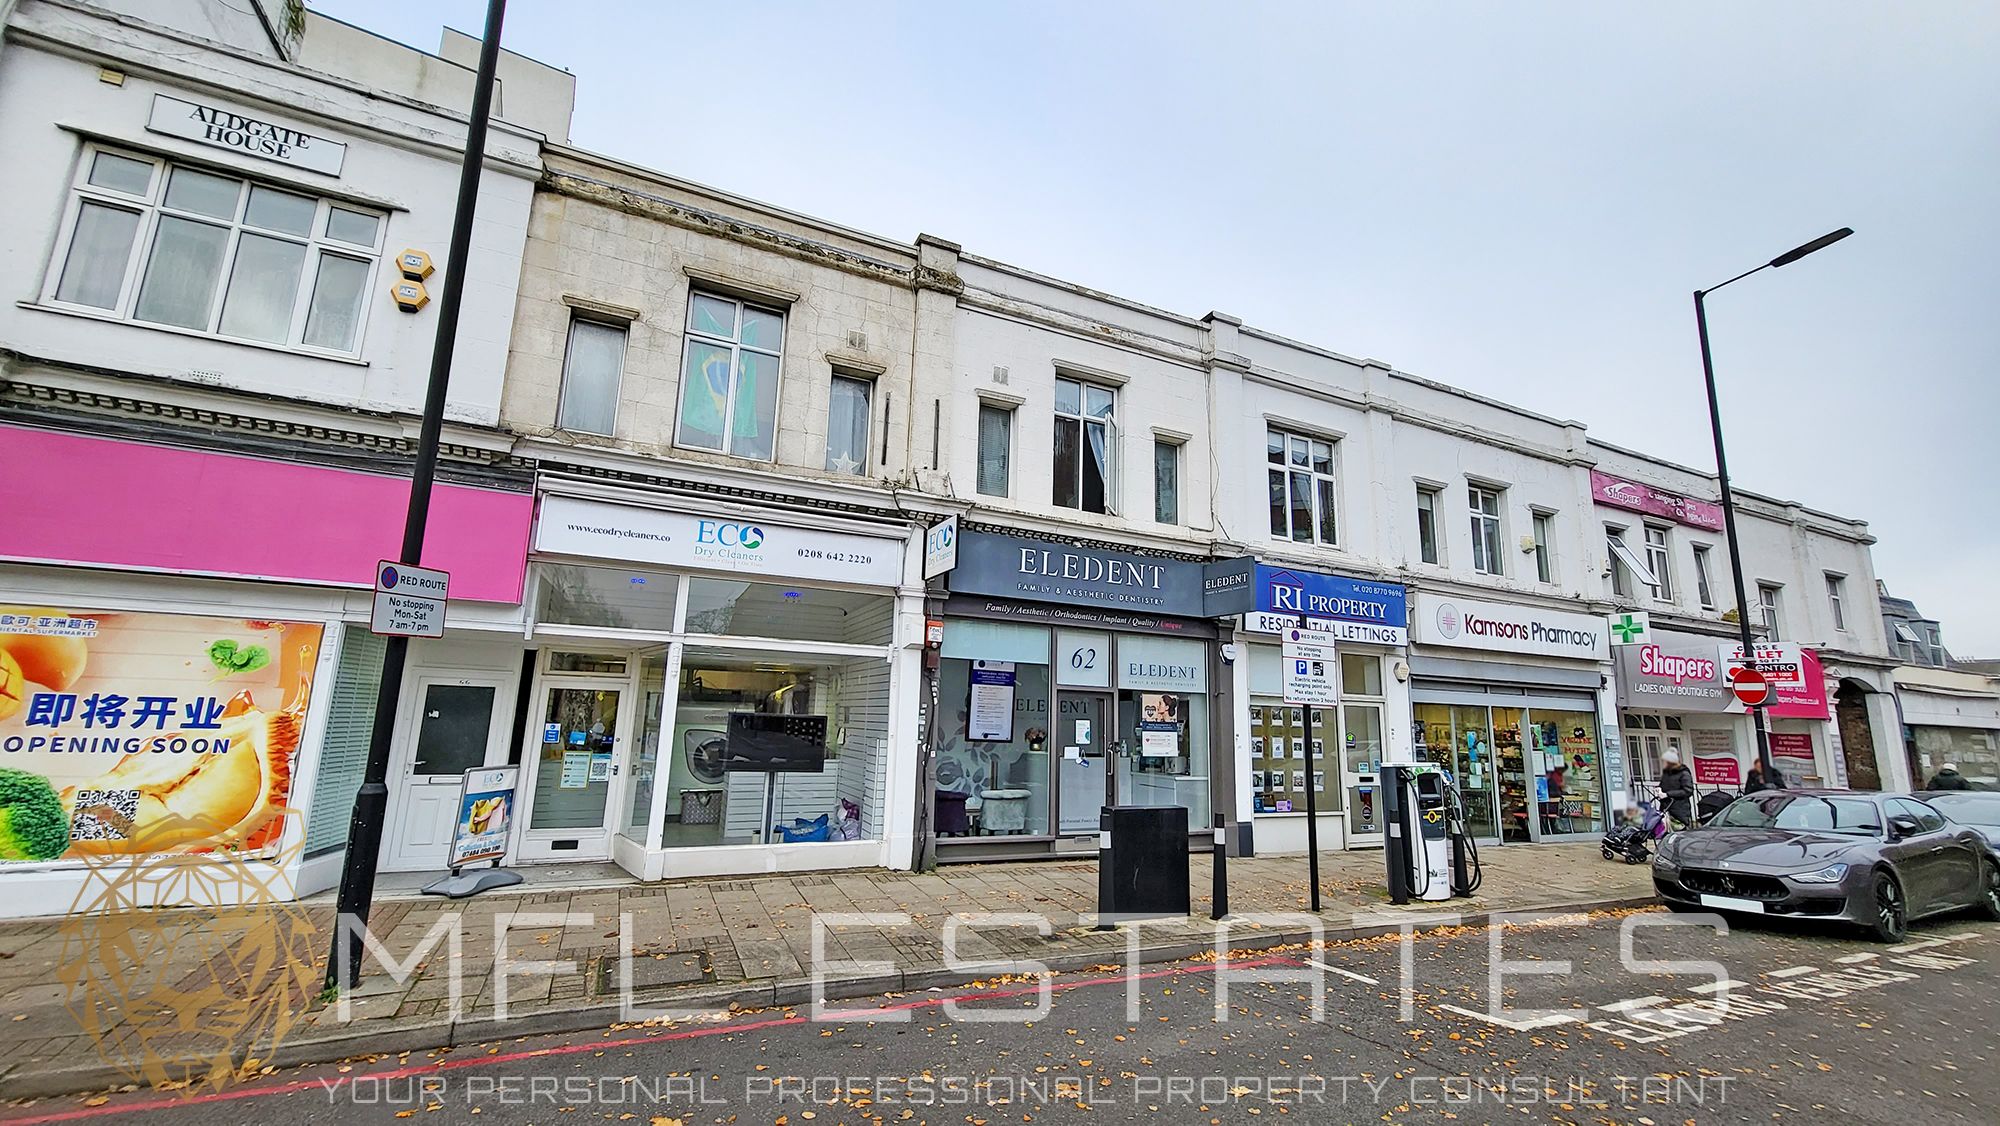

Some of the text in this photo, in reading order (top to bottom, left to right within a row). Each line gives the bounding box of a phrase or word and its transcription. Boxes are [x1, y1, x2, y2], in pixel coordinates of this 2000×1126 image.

[189, 105, 311, 149] ALDGATE
[203, 124, 292, 160] HOUSE
[404, 255, 422, 267] ADT
[399, 286, 418, 298] ADT
[1608, 487, 1642, 506] Shapers
[567, 524, 671, 542] www.ecodrycleaners.co
[697, 520, 765, 550] ECO
[929, 524, 953, 555] ECO
[694, 545, 764, 562] Dry Cleaners
[797, 549, 872, 564] 0208 642 2220
[1018, 547, 1165, 589] ELEDENT
[400, 575, 446, 591] RED ROUTE
[1205, 572, 1249, 590] ELEDENT
[1017, 583, 1051, 593] FAMILY
[1066, 588, 1114, 600] AESTHETIC
[1119, 594, 1165, 606] DENTISTRY
[1361, 586, 1372, 594] 020
[1374, 587, 1388, 596] 8770
[1388, 589, 1402, 597] 9696
[388, 597, 434, 612] No stopping
[1272, 584, 1387, 619] RI PROPERTY
[394, 609, 427, 620] Mon-Sat
[985, 603, 1012, 614] Family
[1017, 606, 1049, 617] Aesthetic
[1054, 609, 1097, 621] Orthodontics
[1102, 614, 1127, 625] Implant
[1132, 618, 1155, 628] Quality
[37, 628, 97, 637] SUPERMARKET
[1342, 627, 1397, 643] LETTINGS
[1464, 613, 1597, 651] Kamsons Pharmacy
[1071, 647, 1096, 669] 62
[1757, 651, 1783, 659] LET
[1129, 663, 1197, 679] ELEDENT
[1640, 645, 1715, 684] Shapers
[1634, 682, 1723, 699] LADIES ONLY BOUTIQUE GYM
[25, 693, 228, 730] 即将开业
[3, 736, 230, 754] OPENING SOON
